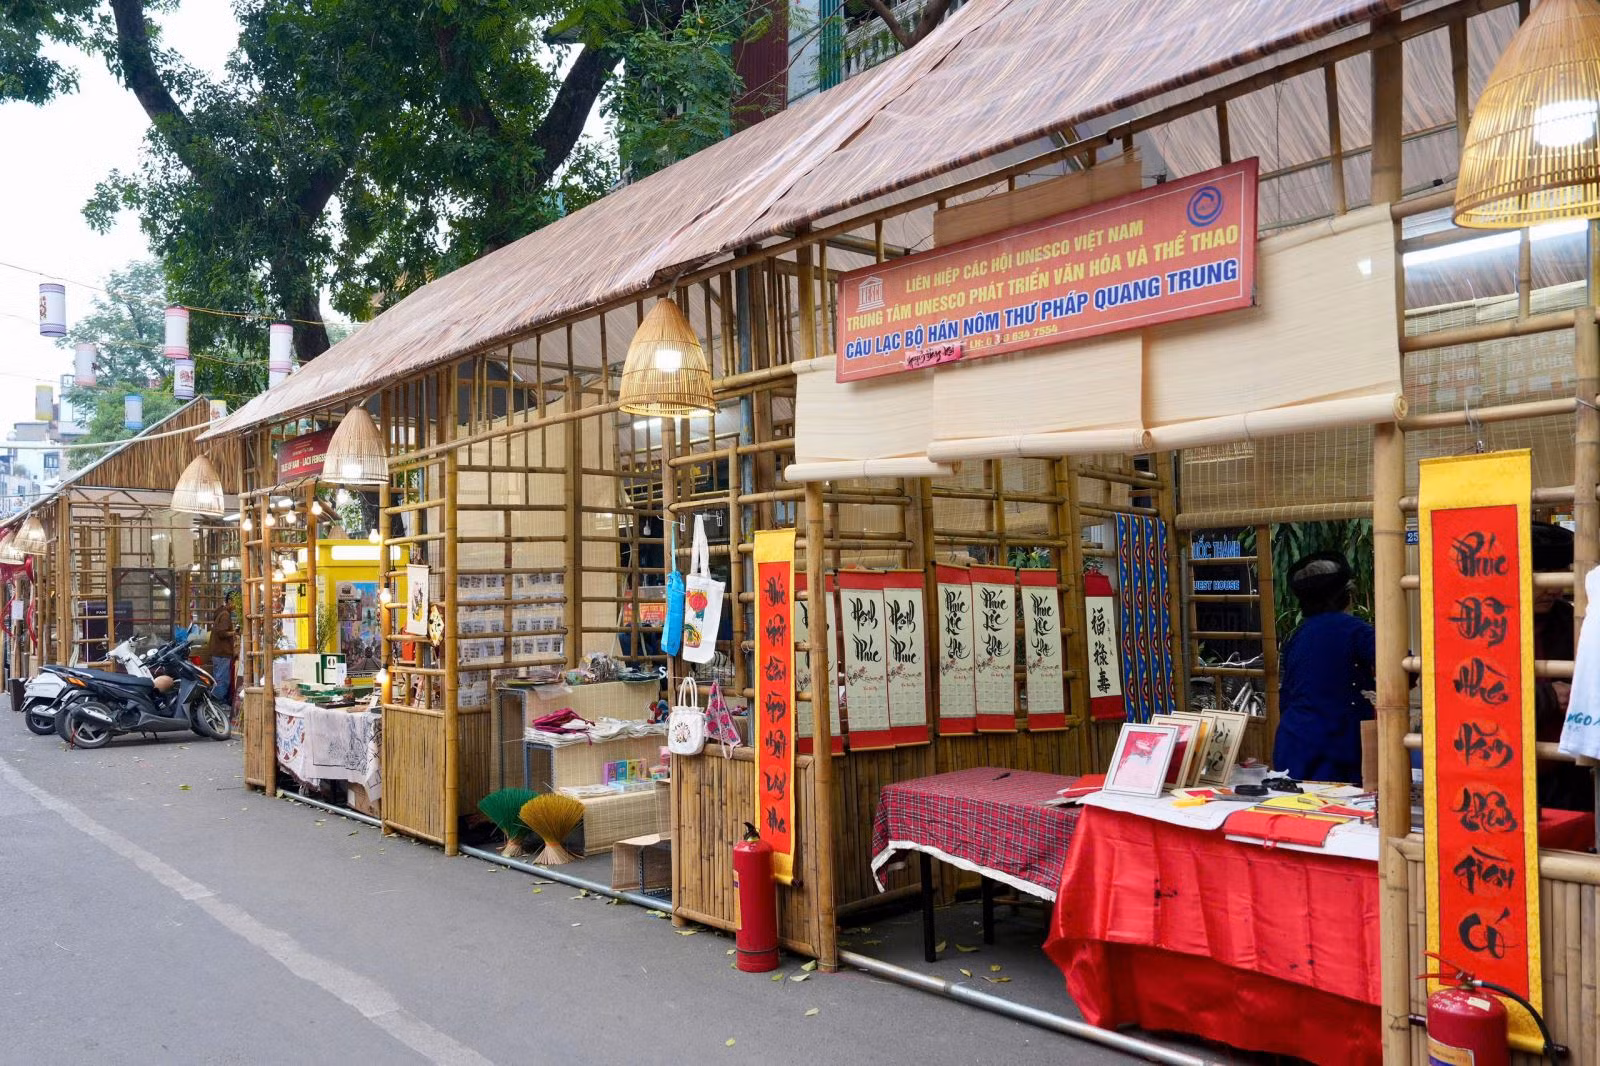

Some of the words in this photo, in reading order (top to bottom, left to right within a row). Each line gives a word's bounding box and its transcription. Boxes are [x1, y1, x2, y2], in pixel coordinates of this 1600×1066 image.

[906, 275, 930, 294] LIÊN
[934, 267, 960, 287] HIỆP
[963, 260, 988, 280] CÁC
[992, 252, 1012, 274] HỘI
[1016, 240, 1070, 266] UNESCO
[1074, 230, 1104, 252] VIỆT
[1108, 220, 1144, 244] NAM
[847, 312, 883, 332] TRUNG
[886, 303, 912, 322] TÂM
[915, 291, 966, 316] UNESCO
[969, 281, 1004, 304] PHÁT
[1008, 267, 1050, 296] TRIỂN
[1054, 262, 1084, 285] VĂN
[1089, 254, 1122, 278] HÓA
[1126, 245, 1148, 268] VÀ
[1153, 230, 1187, 262] THỂ
[1190, 224, 1238, 252] THAO
[859, 285, 883, 304] UNESCO
[846, 338, 872, 359] CÂU
[876, 334, 900, 355] LẠC
[905, 325, 924, 350] BỘ
[928, 317, 958, 343] HÁN
[963, 310, 999, 336] NÔM
[1005, 302, 1038, 328] THƯ
[1041, 290, 1088, 321] PHÁP
[1094, 278, 1161, 310] QUANG
[1166, 259, 1238, 294] TRUNG
[970, 339, 984, 348] LH:
[1450, 530, 1509, 577] Phúc
[980, 587, 1008, 610] Phúc
[1193, 580, 1212, 590] UEST
[1213, 580, 1240, 590] HOUSE
[944, 588, 970, 614] Phúc
[1030, 593, 1054, 616] Phúc
[852, 634, 882, 662] Phúc
[890, 634, 920, 664] Phúc
